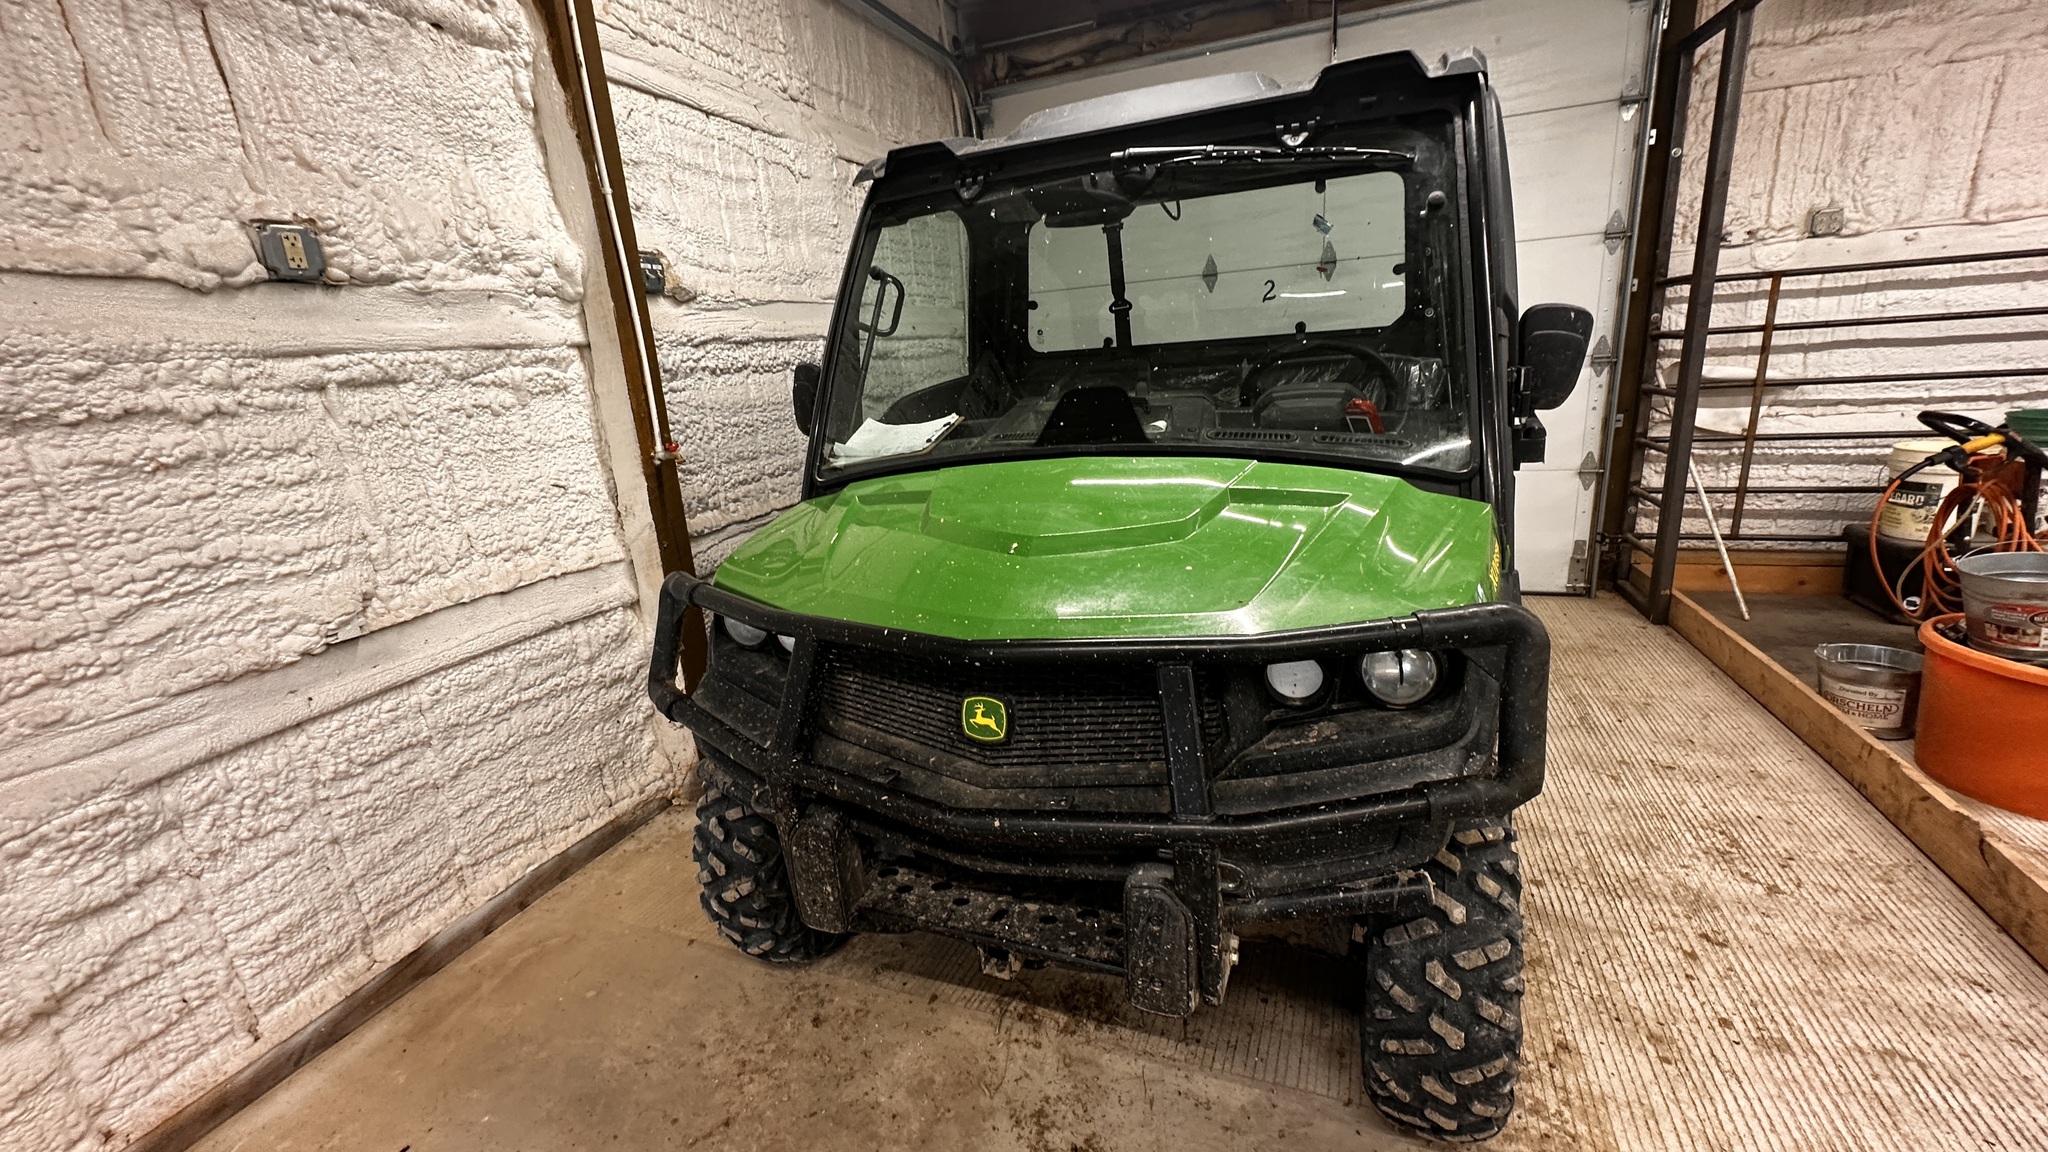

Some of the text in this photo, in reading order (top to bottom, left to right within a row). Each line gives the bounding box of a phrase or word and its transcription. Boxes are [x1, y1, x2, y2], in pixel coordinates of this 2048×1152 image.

[1262, 279, 1277, 303] 2
[1825, 693, 1893, 714] ORSCHELN
[1858, 711, 1889, 720] HOME
